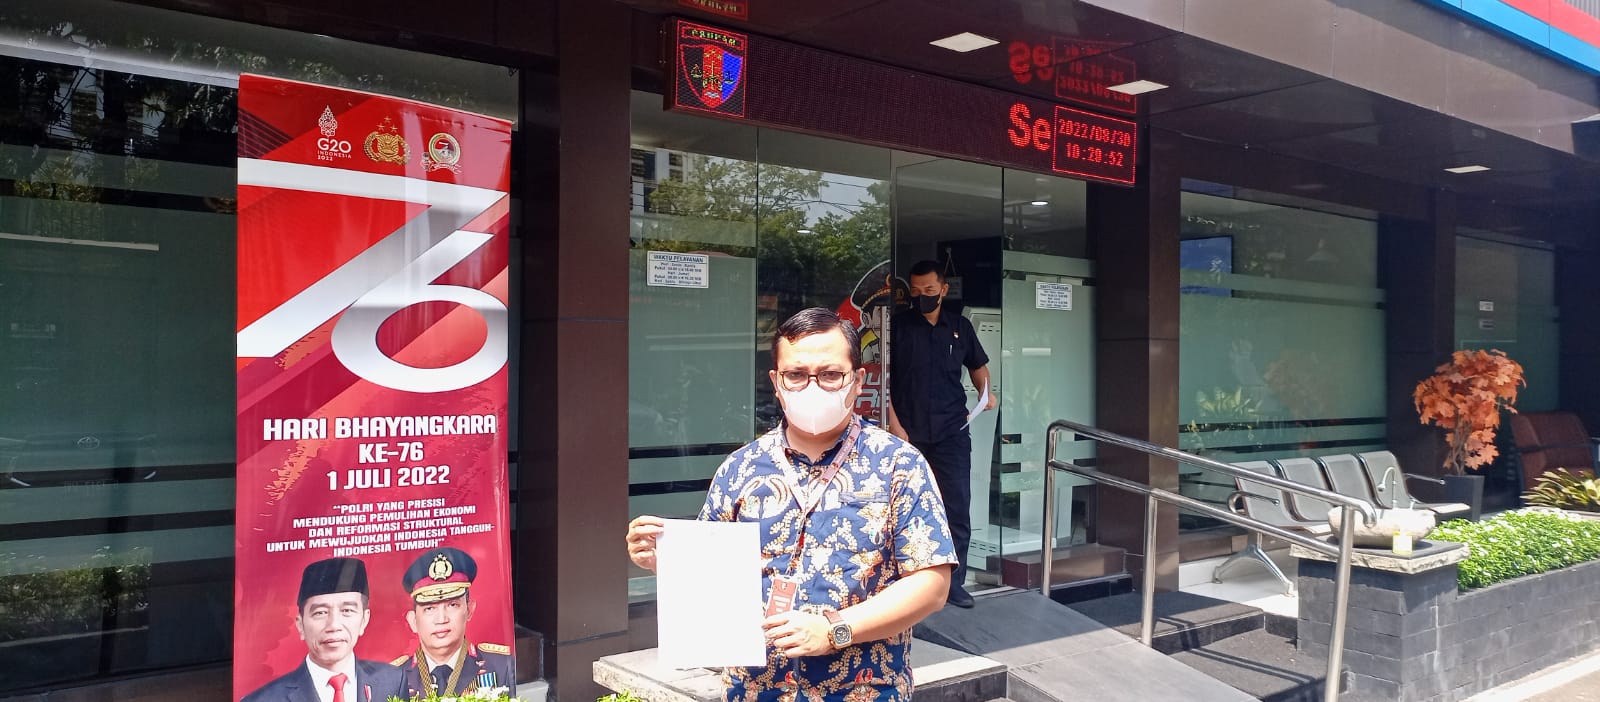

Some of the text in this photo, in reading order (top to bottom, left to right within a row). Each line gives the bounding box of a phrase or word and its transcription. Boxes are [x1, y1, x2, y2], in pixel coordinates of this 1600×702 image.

[1008, 103, 1051, 151] Se
[317, 138, 352, 154] G20
[318, 150, 352, 159] INDONESIA
[263, 414, 496, 440] HARI BHAYANGKARA
[359, 441, 424, 464] KE-76
[326, 465, 450, 490] 1 JULI 2022
[293, 505, 476, 528] MENDUKUNG PEMULIHAN EKONOMI
[376, 501, 404, 512] YANG
[408, 498, 445, 509] PRESISI
[266, 522, 496, 552] UNTUK MEWUJUDKAN INDONESIA TANGGUH-
[308, 516, 464, 538] DAN REFORMASI STRUKTURAL
[333, 544, 392, 558] INDONESIA
